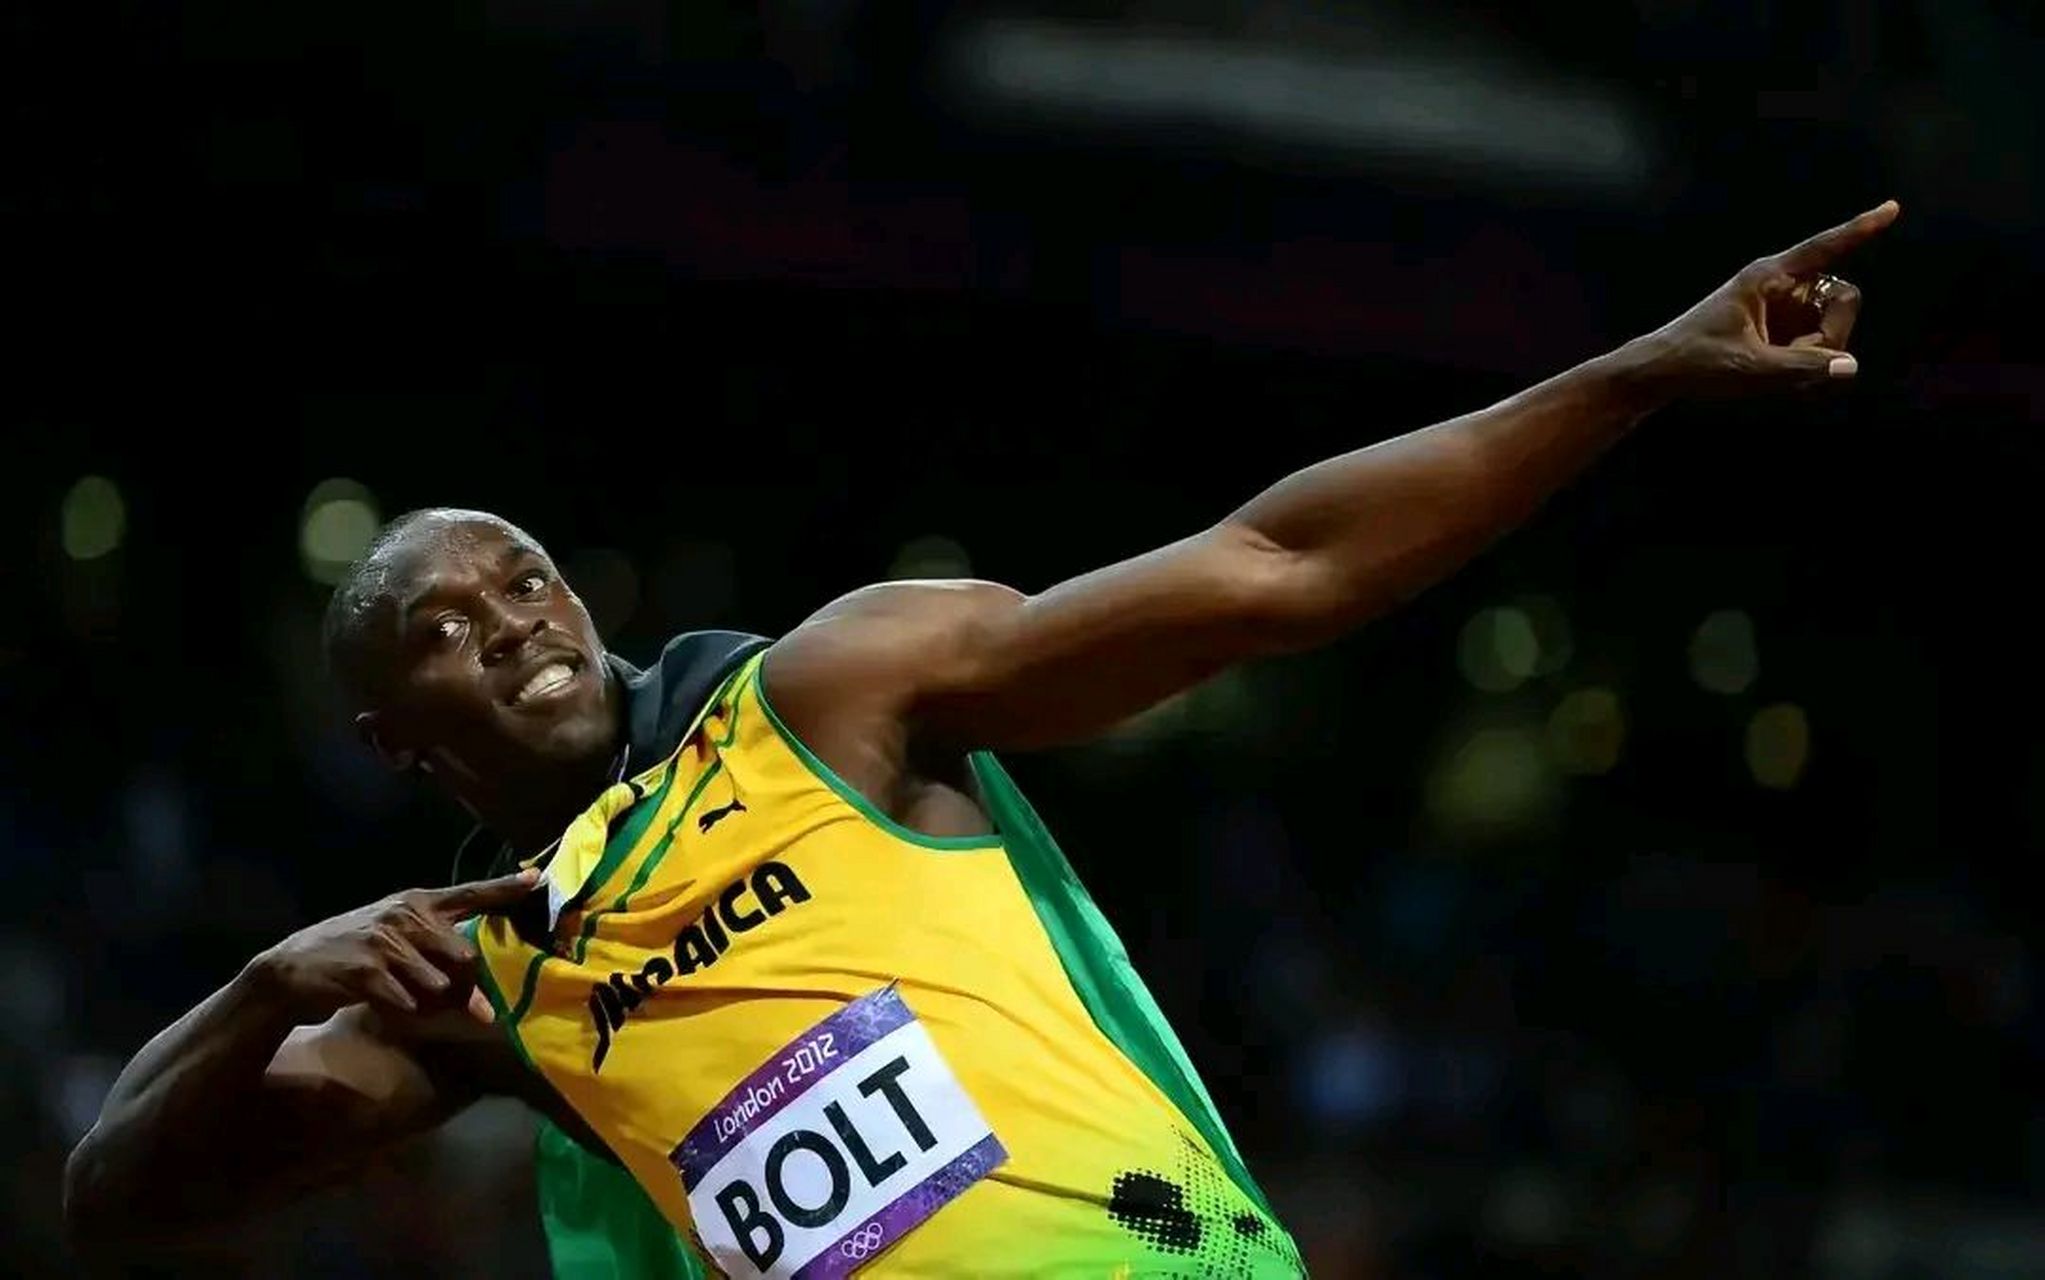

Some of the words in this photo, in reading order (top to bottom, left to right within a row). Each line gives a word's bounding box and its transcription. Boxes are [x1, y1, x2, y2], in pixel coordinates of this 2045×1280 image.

[713, 1076, 785, 1143] London
[782, 1032, 838, 1084] 2012
[715, 1055, 938, 1274] BOLT
